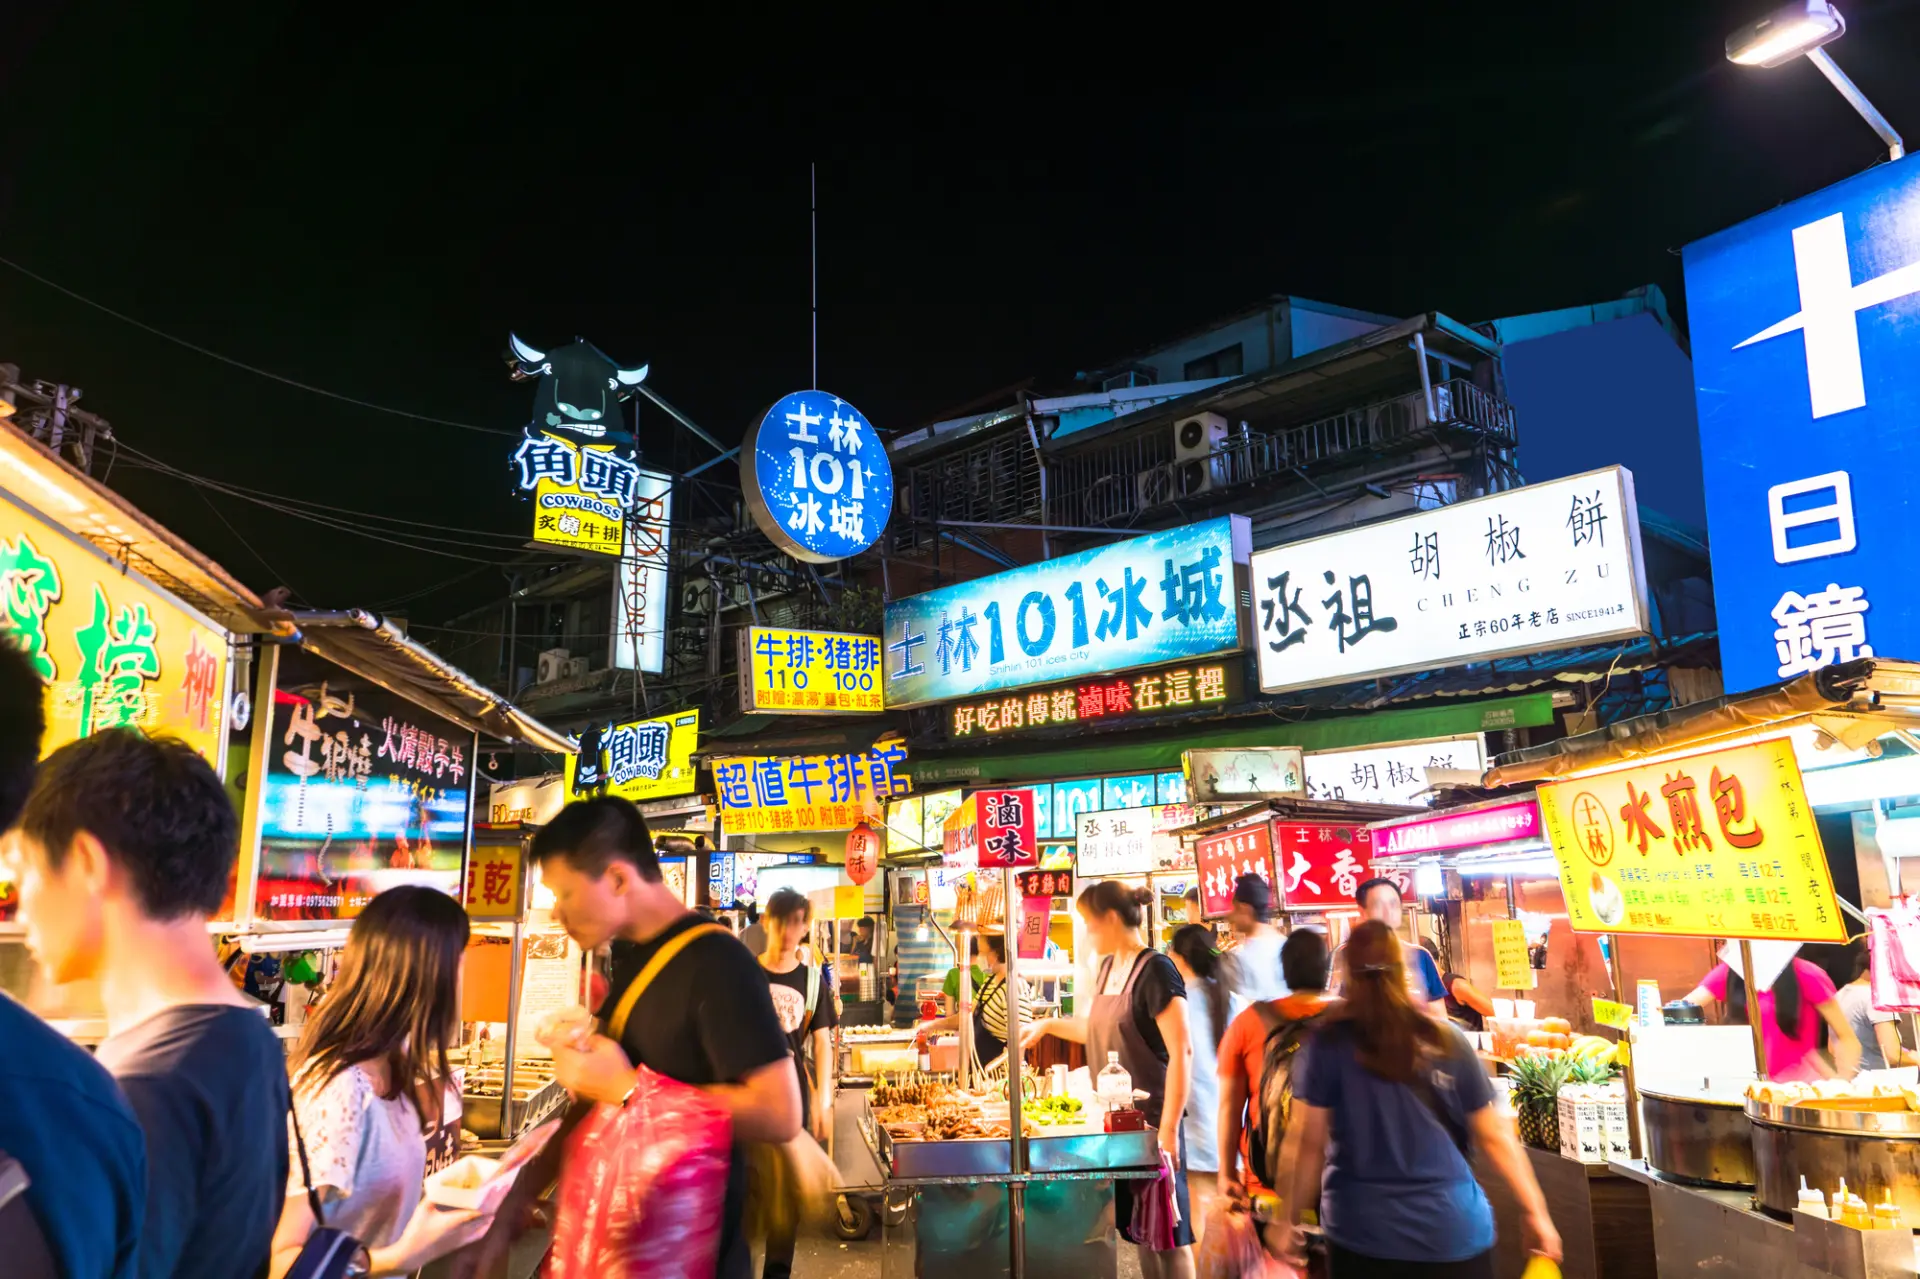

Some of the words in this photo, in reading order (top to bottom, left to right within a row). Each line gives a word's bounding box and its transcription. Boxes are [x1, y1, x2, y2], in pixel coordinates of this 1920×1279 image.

[786, 403, 863, 455] 士林
[515, 439, 640, 508] 角頭
[788, 447, 865, 500] 101
[537, 512, 621, 543] 炙燒牛排
[787, 492, 866, 545] 冰城
[1408, 489, 1609, 582] 胡椒餅
[624, 560, 648, 646] STORE
[888, 546, 1228, 681] 士林101冰城
[1260, 570, 1398, 654] 丞祖
[1416, 578, 1531, 612] CHENG
[1564, 563, 1610, 585] ZU
[1458, 608, 1560, 640] 正宗60年老店
[764, 669, 808, 689] 110
[832, 672, 873, 691] 100
[1025, 658, 1042, 669] 101
[1069, 650, 1090, 661] city
[610, 721, 669, 775] 角頭
[716, 743, 911, 811] 超值牛排館
[985, 794, 1031, 864] 滷味
[1083, 818, 1134, 838] 丞祖
[1296, 827, 1332, 843] 士林
[1578, 798, 1608, 859] 士林
[1620, 765, 1765, 857] 水煎包
[1025, 915, 1041, 936] 租
